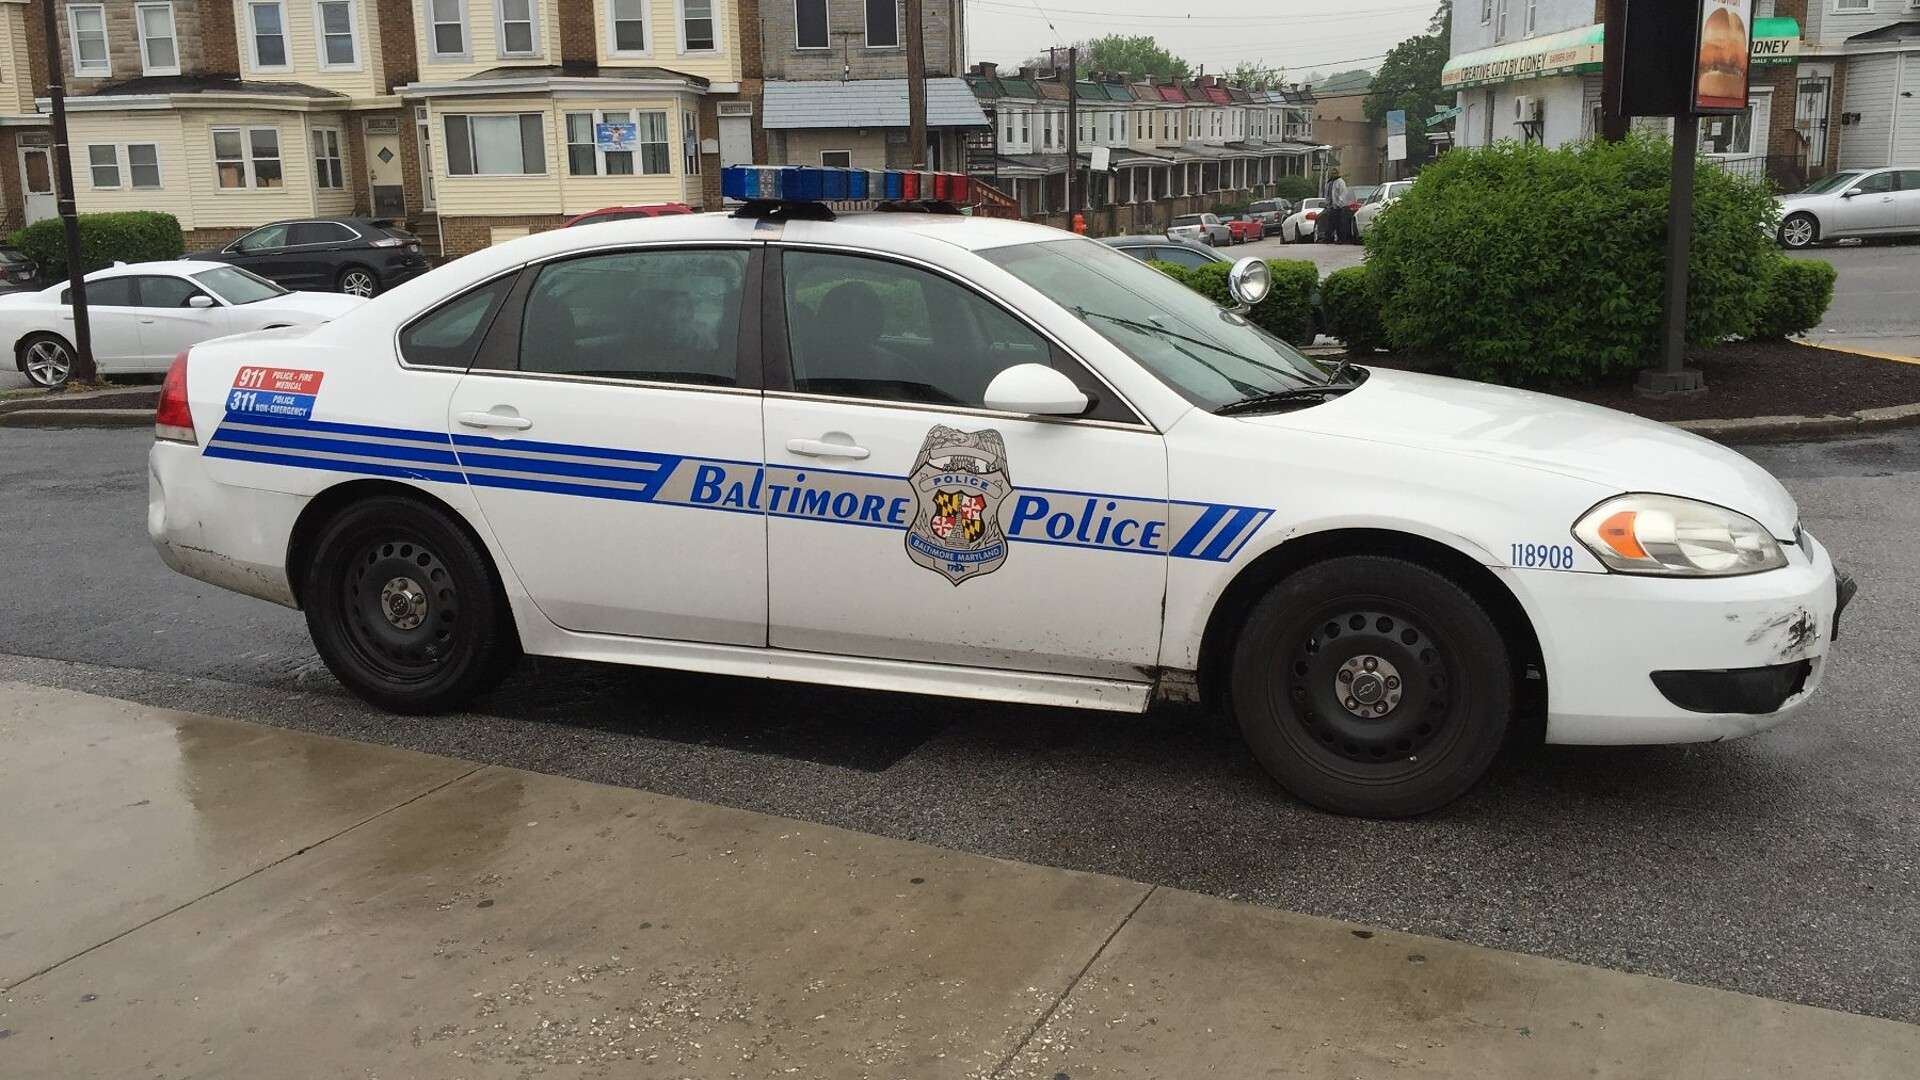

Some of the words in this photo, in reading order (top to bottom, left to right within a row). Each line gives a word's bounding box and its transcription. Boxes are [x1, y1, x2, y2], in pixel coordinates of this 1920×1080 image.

[1460, 63, 1490, 82] CREATIVE
[1490, 59, 1509, 77] CUTZ
[1509, 57, 1519, 74] BY
[1519, 53, 1548, 72] CIDNEY
[238, 368, 267, 388] 911
[272, 371, 295, 381] POLICE
[299, 373, 314, 382] FIRE
[274, 381, 302, 390] MEDICAL
[230, 391, 257, 411] 311
[255, 403, 308, 416] NON-EMERGENCY
[272, 395, 296, 405] POLICE
[933, 474, 990, 491] POLICE
[1008, 495, 1166, 549] Police
[913, 537, 954, 561] BALTIMORE
[957, 549, 1000, 562] MARYLAND
[1511, 543, 1573, 569] 118908
